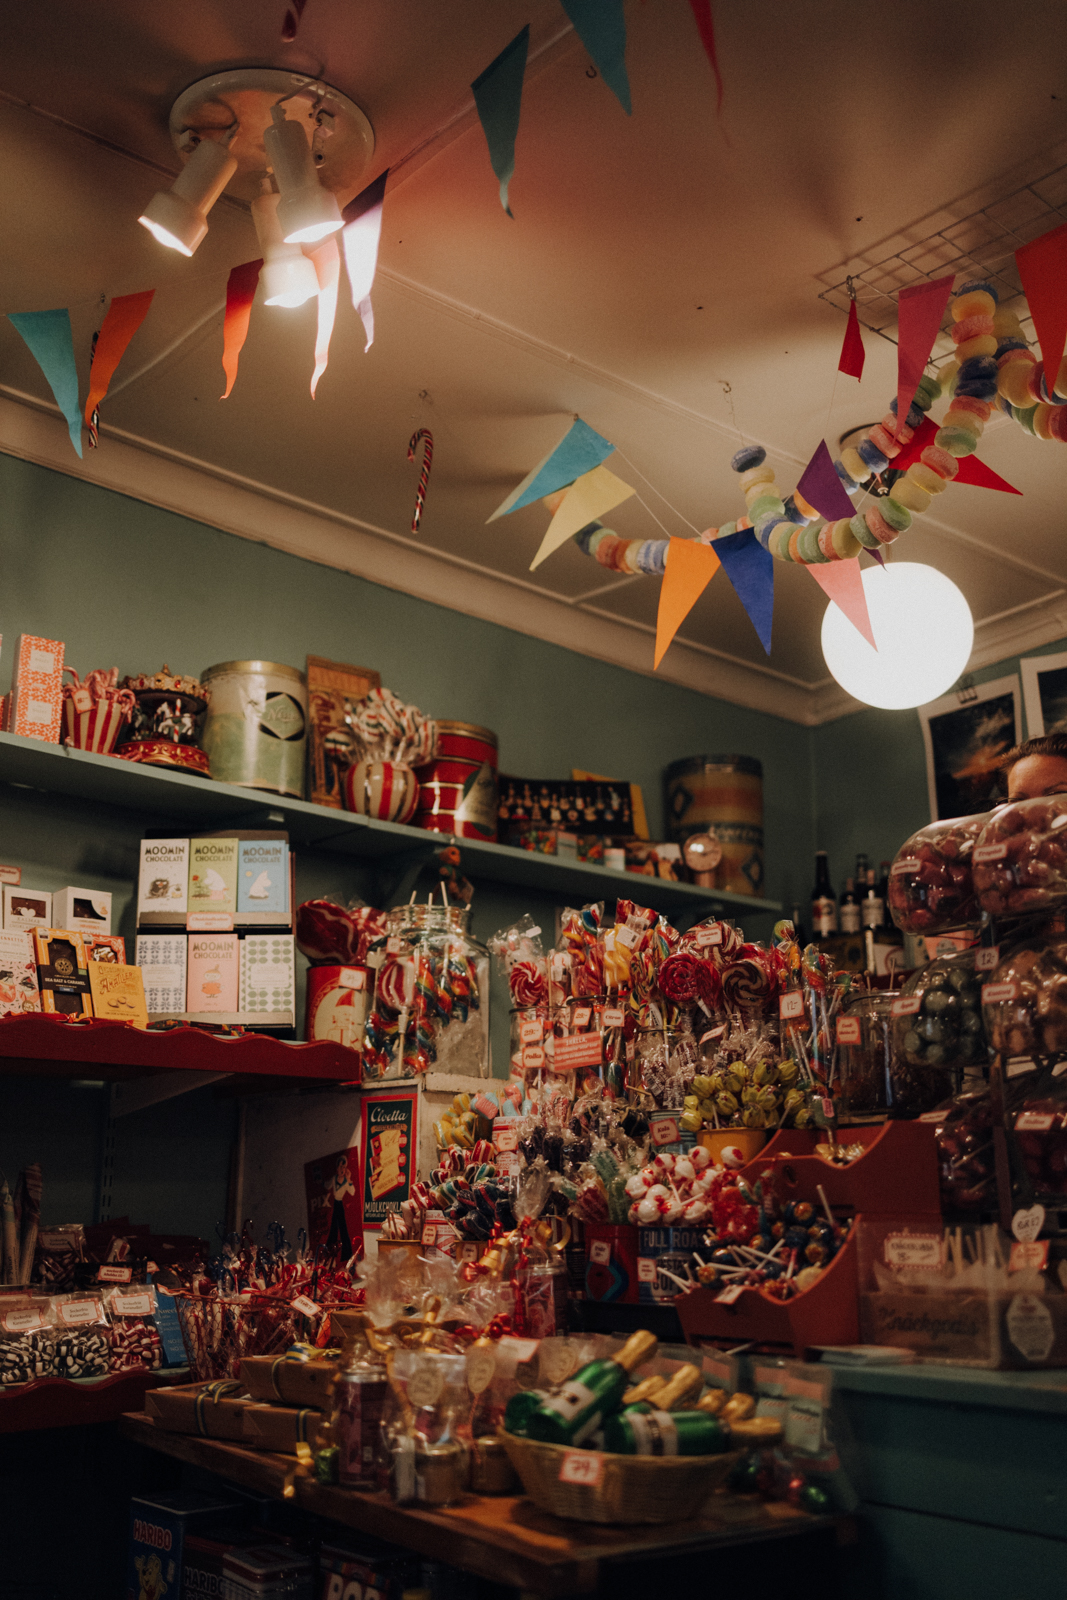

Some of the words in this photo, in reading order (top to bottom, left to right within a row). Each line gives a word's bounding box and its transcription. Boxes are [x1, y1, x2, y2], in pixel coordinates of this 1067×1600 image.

[145, 846, 185, 855] MOOMIN
[194, 846, 234, 855] MOOMIN
[243, 847, 282, 856] MOOMIN
[193, 941, 234, 951] MOOMIN
[525, 1052, 542, 1060] Polka
[370, 1106, 409, 1123] Cloetta
[643, 1230, 668, 1248] FULL
[133, 1518, 172, 1551] HARIBO
